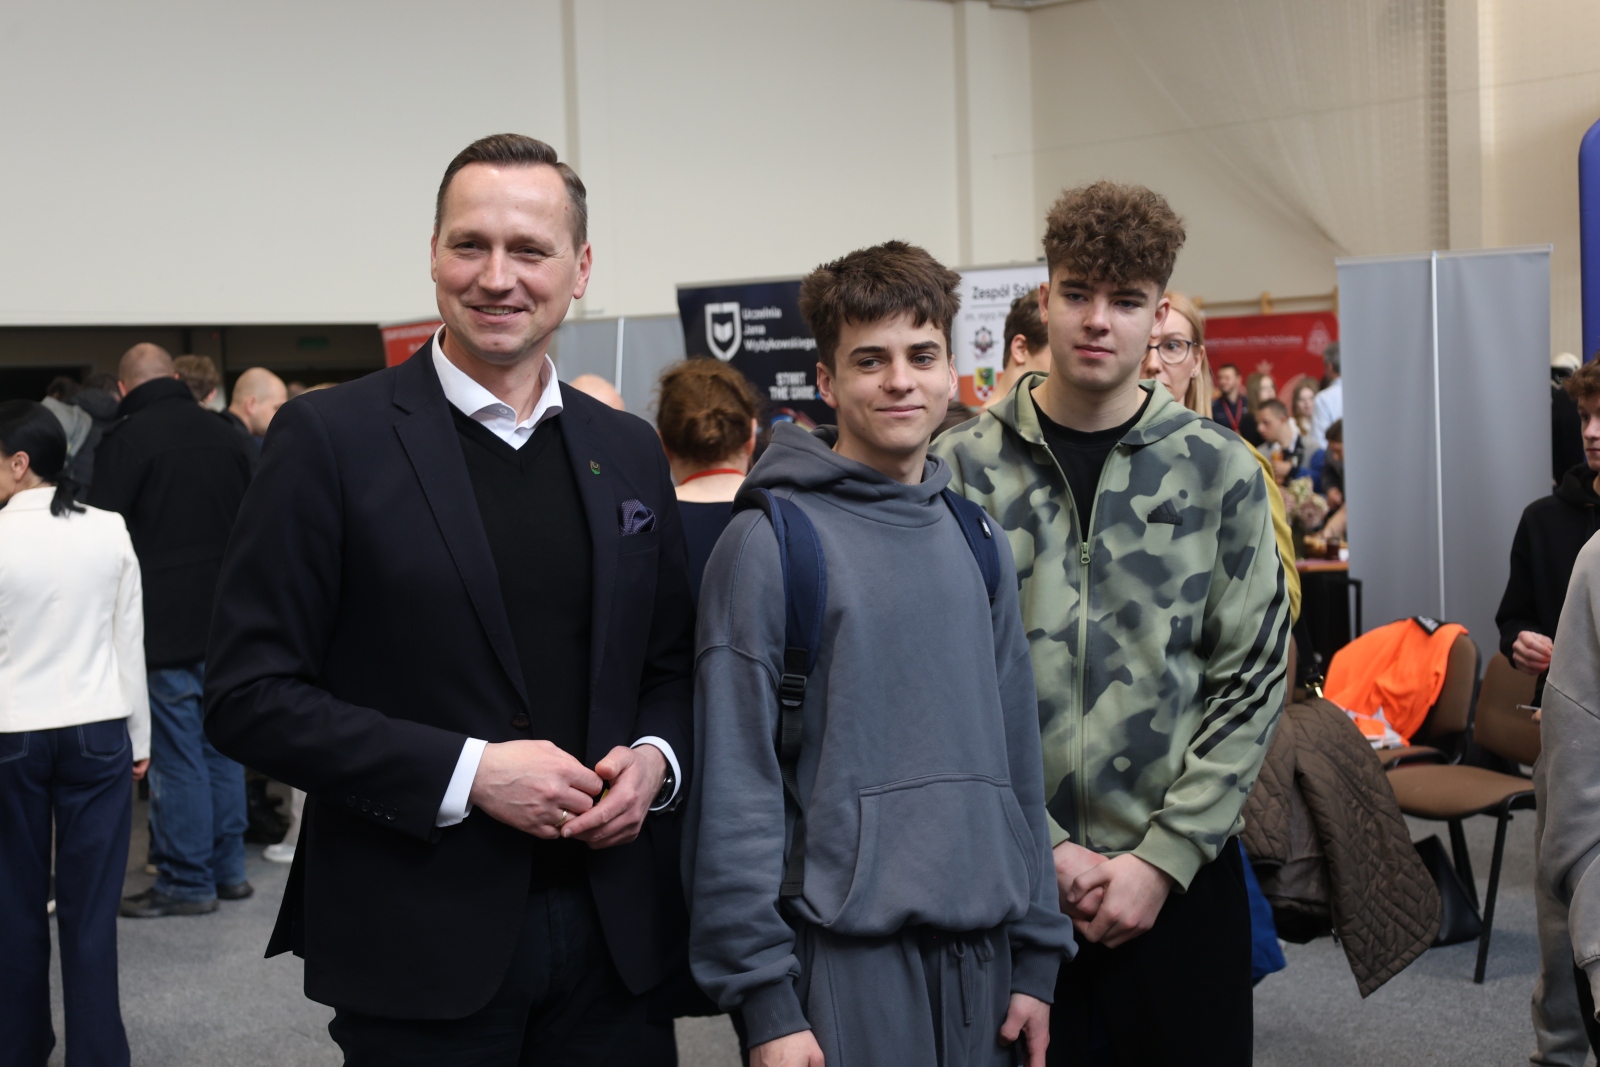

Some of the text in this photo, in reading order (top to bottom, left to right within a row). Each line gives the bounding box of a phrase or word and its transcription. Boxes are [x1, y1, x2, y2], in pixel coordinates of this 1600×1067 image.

[972, 284, 1010, 300] Zespół
[742, 307, 782, 320] Uczelnia
[743, 324, 766, 336] Jana
